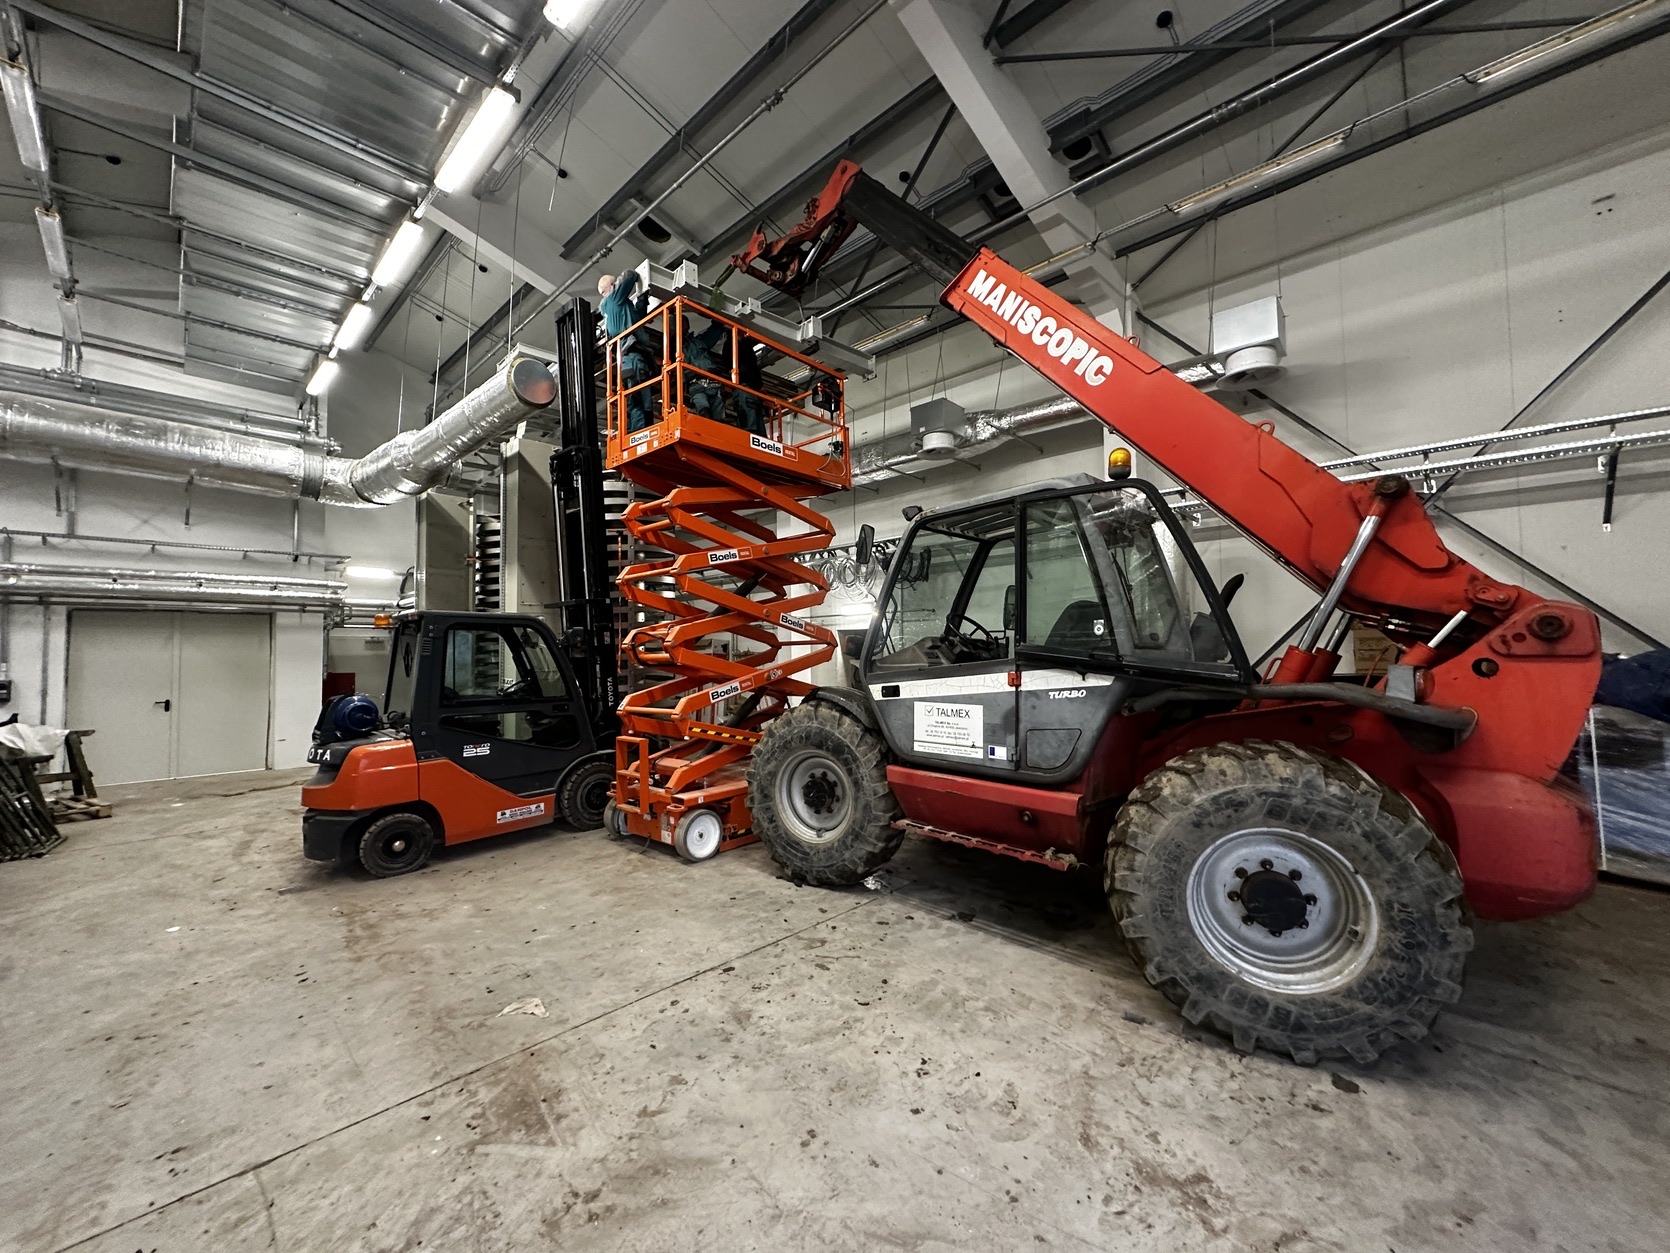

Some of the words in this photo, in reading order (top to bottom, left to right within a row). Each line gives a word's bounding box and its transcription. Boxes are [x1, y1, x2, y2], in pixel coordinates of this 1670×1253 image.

[967, 268, 1114, 386] MANISCOPIC
[631, 433, 649, 444] Boels
[752, 436, 782, 454] Boels
[709, 551, 738, 562] Boels
[781, 614, 804, 629] Boels
[711, 685, 739, 701] Boels
[1048, 689, 1087, 700] TURBO
[935, 707, 971, 719] TALMEX
[463, 746, 491, 757] 25
